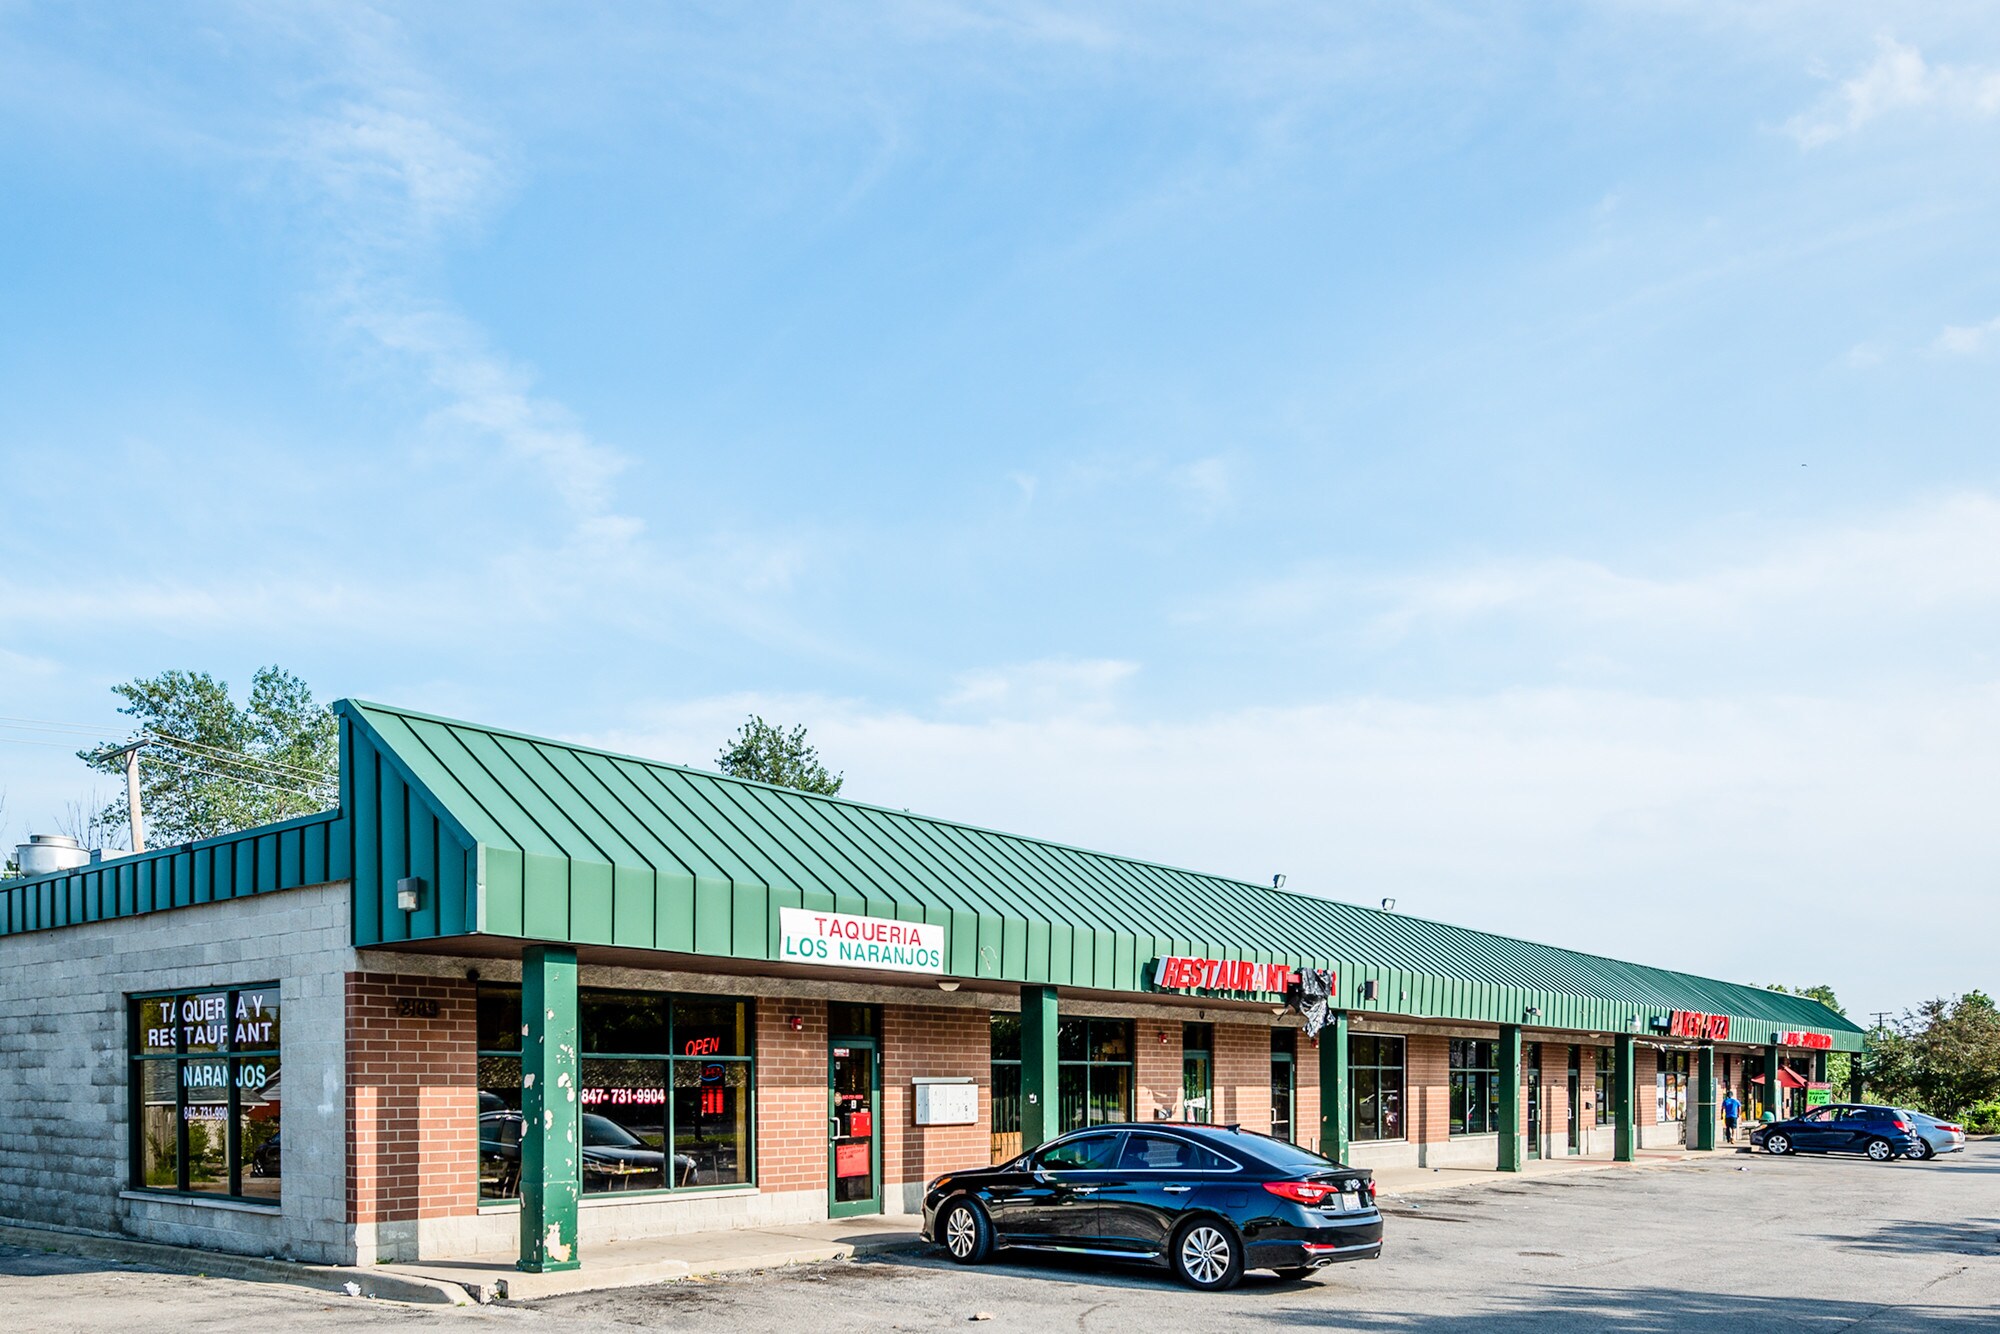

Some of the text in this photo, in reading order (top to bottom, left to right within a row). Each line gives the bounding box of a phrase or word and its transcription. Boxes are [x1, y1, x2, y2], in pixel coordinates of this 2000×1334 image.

[815, 917, 921, 946] TAQUERIA
[786, 936, 940, 967] LOS NARANJOS
[160, 996, 247, 1023] TAQUERA
[685, 1037, 720, 1056] OPEN
